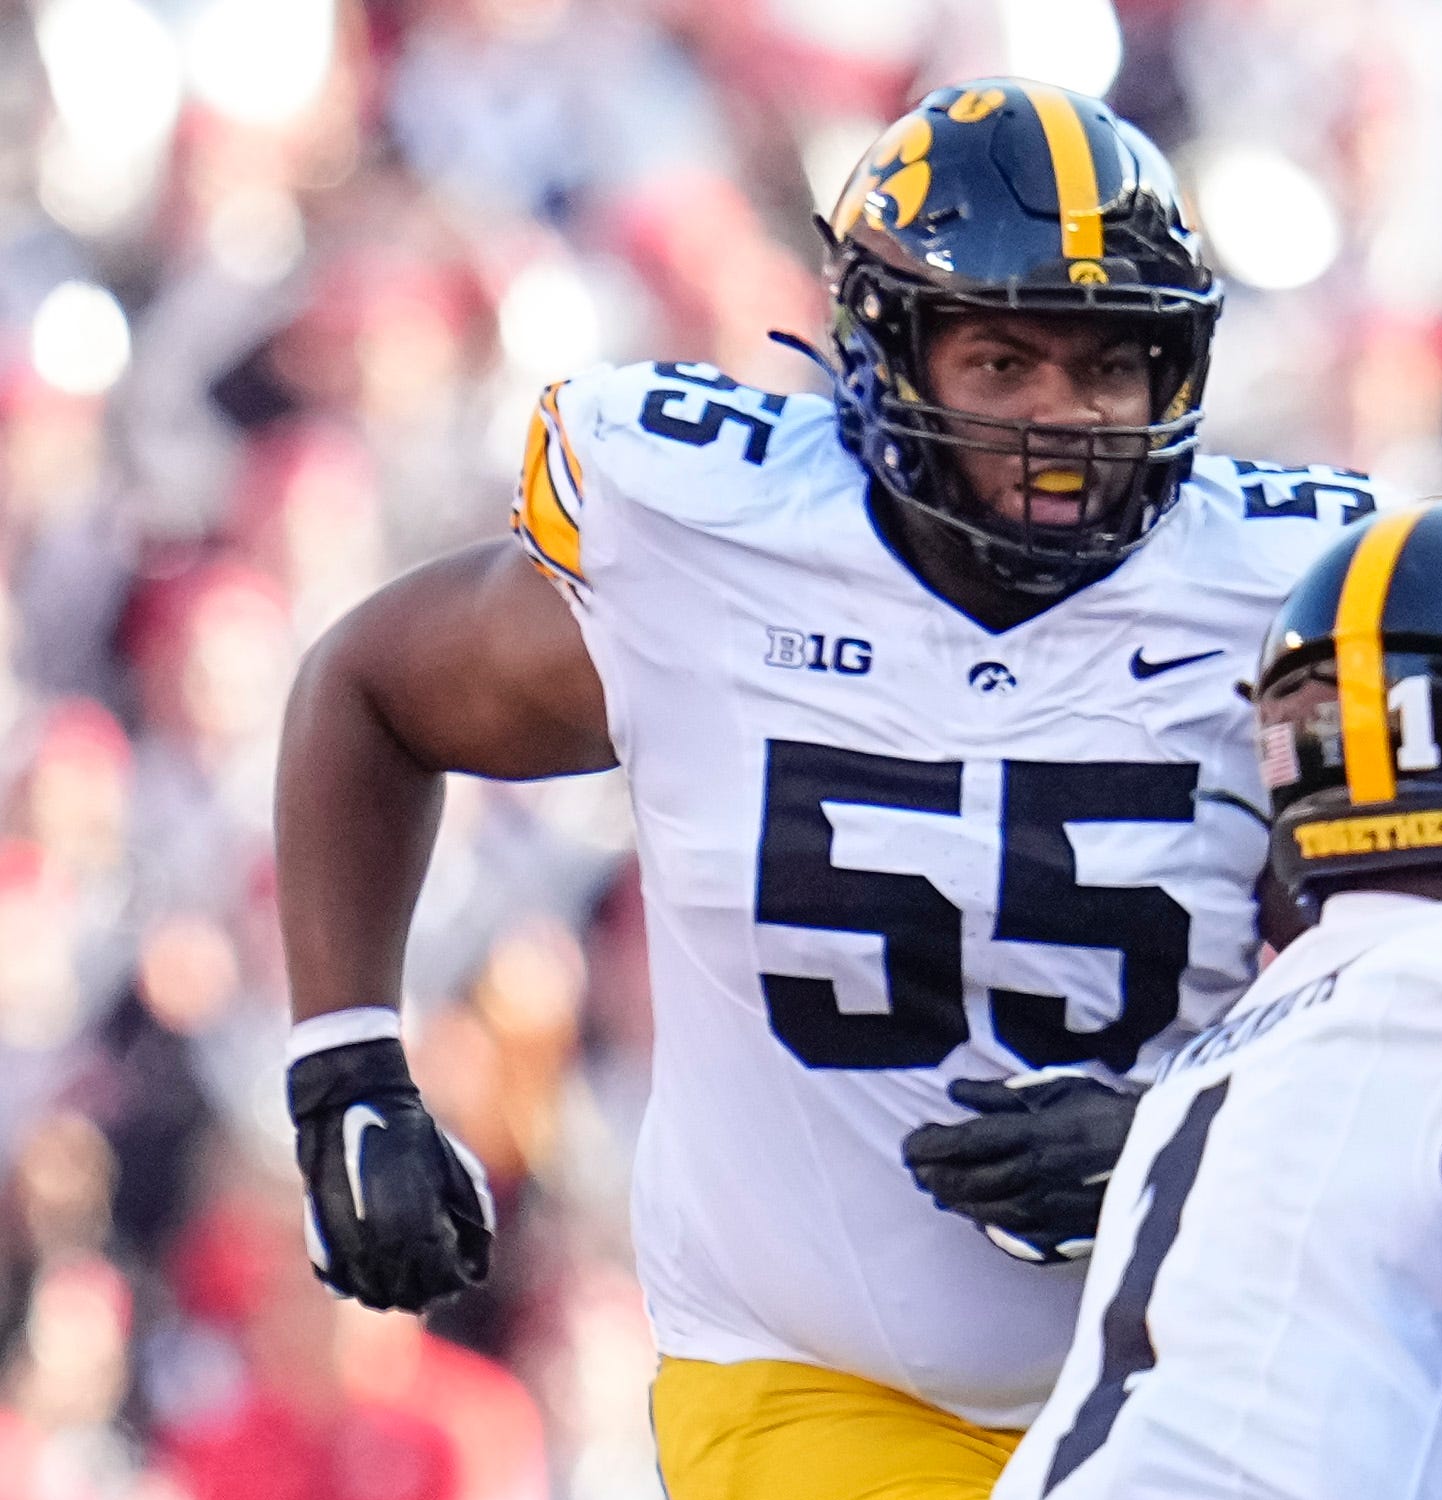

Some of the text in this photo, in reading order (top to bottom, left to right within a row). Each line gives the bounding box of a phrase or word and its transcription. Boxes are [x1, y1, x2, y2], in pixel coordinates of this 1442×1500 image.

[1232, 459, 1377, 526] 5
[1387, 674, 1442, 771] 1
[754, 737, 1201, 1073] 55
[1042, 1072, 1232, 1498] 1
